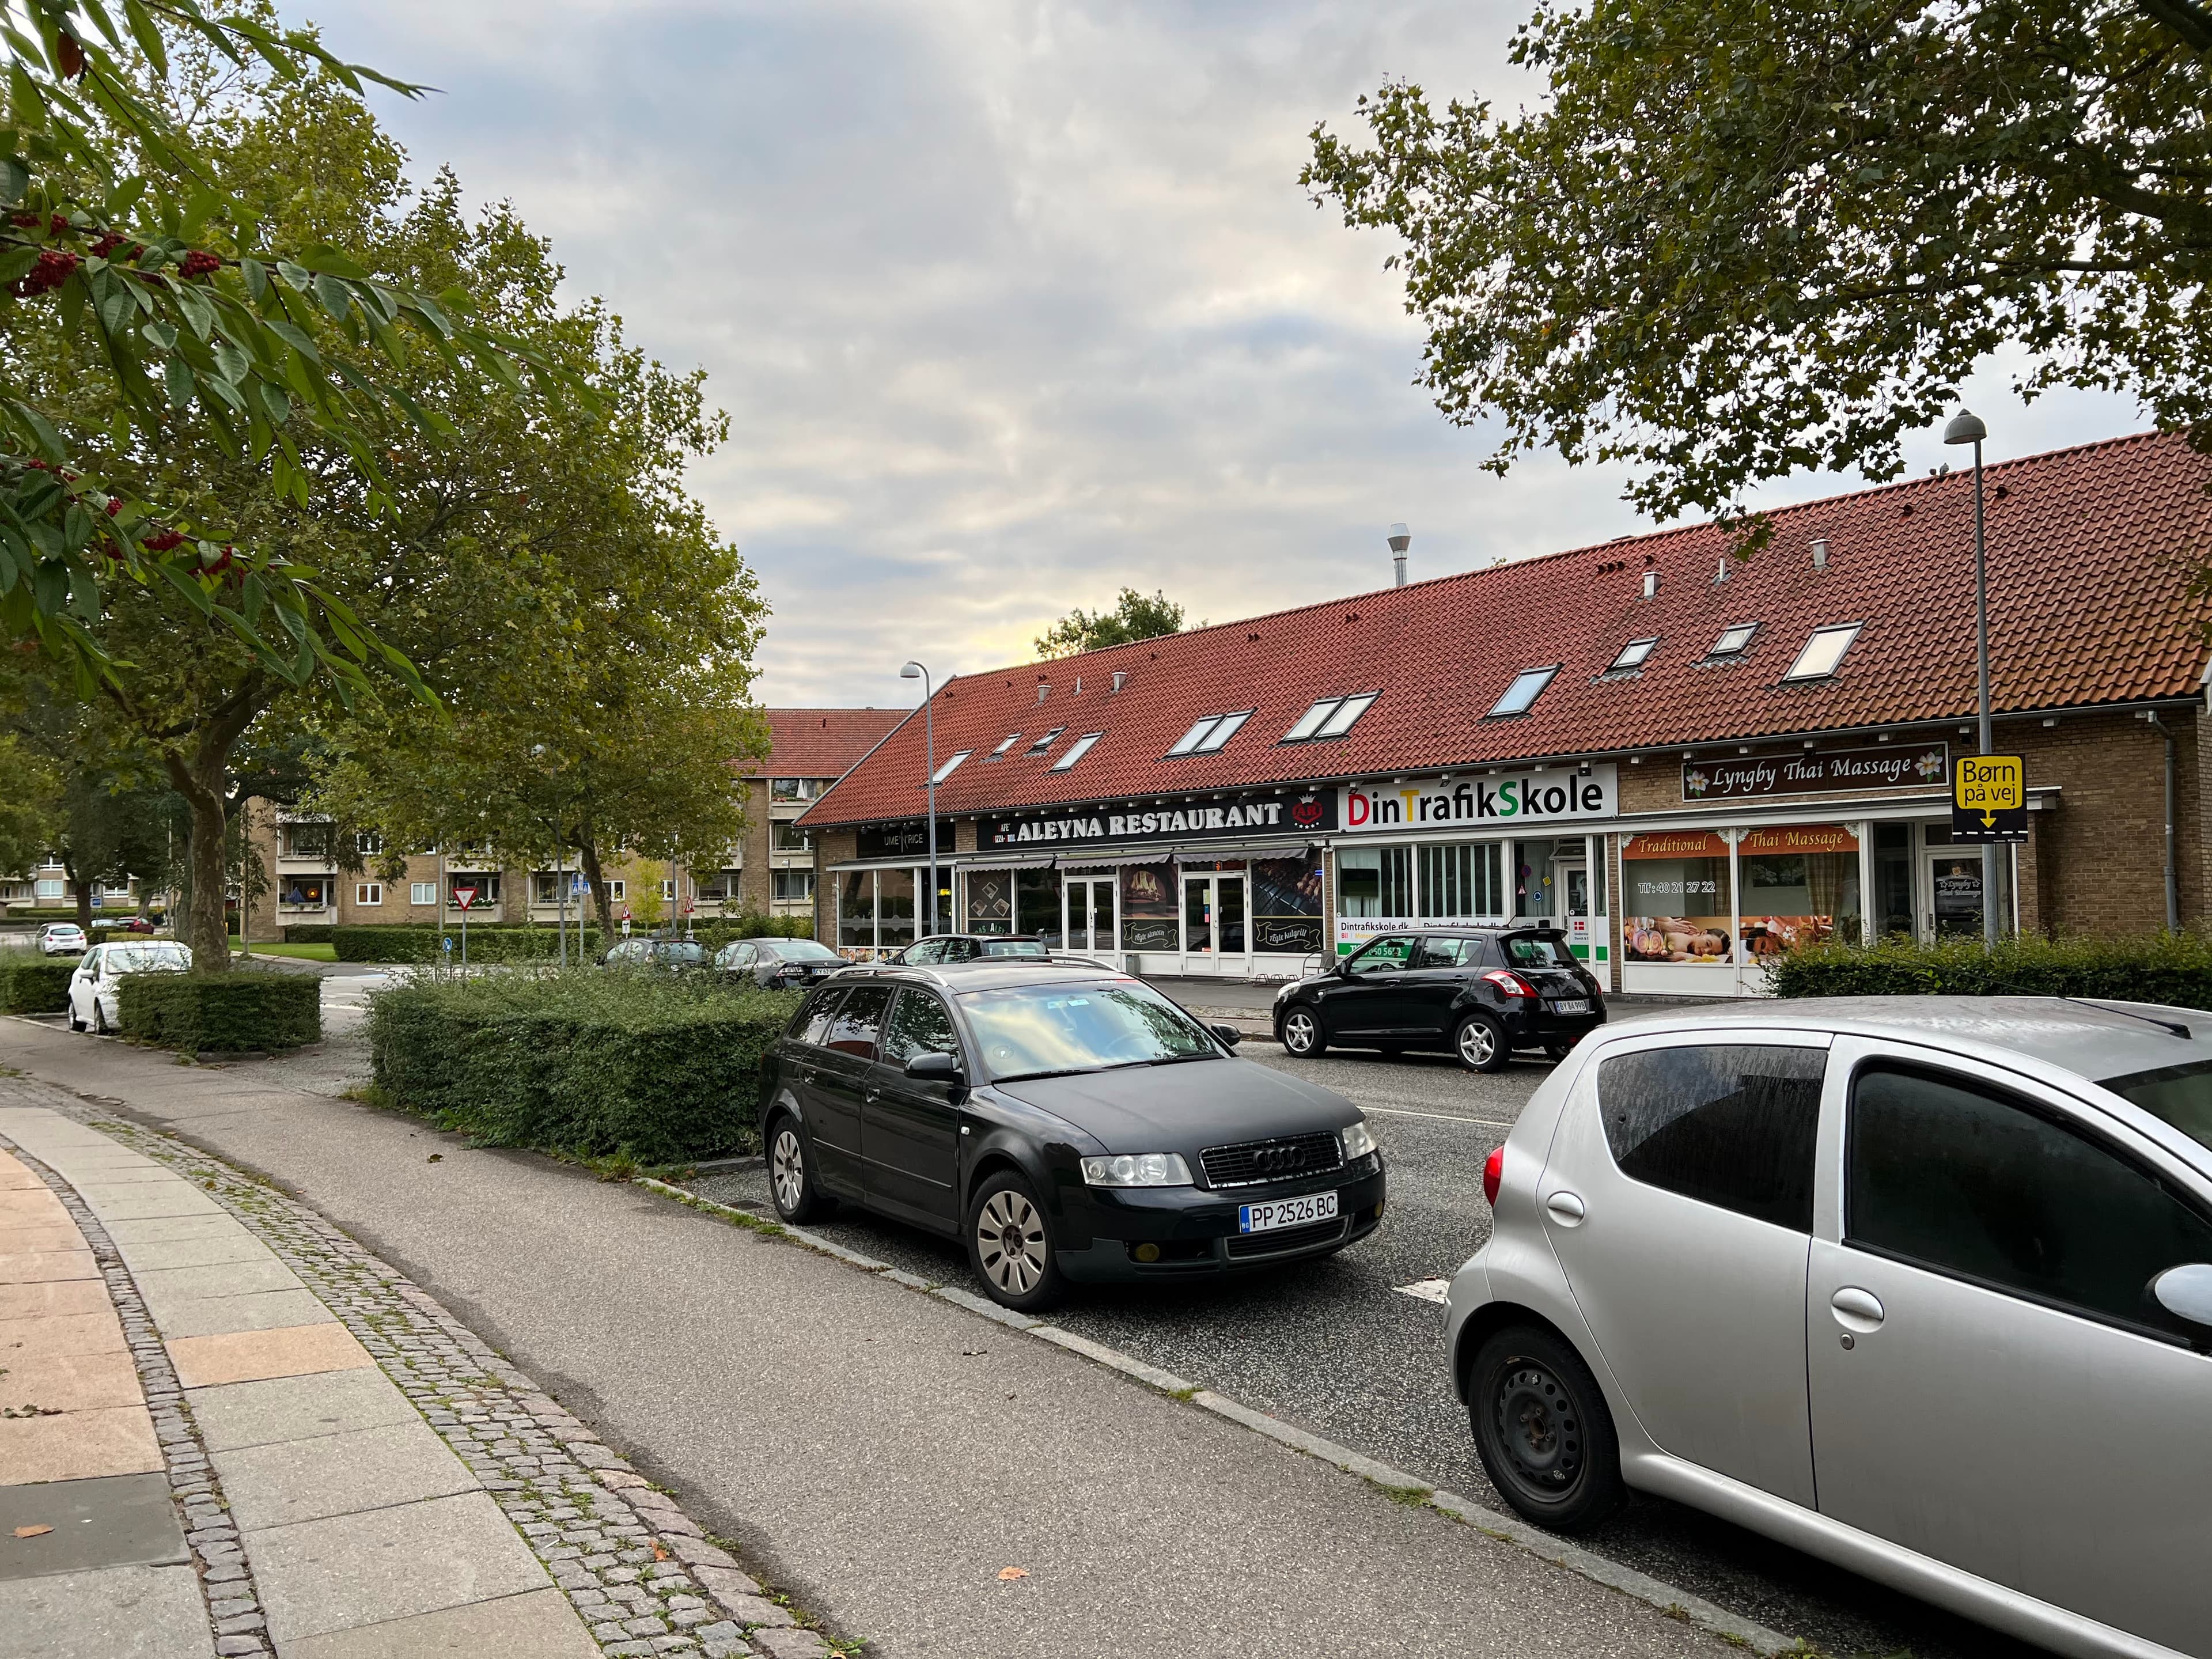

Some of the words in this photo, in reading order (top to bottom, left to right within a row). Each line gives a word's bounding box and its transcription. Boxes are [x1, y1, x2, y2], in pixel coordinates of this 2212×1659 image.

[1712, 761, 1777, 793] Lyngby
[1783, 757, 1824, 780] Thai
[1830, 757, 1911, 782] Massage
[1963, 760, 2015, 783] Børn
[1348, 774, 1603, 826] DinTrafikSkole
[1965, 783, 1986, 806] på
[1990, 783, 2016, 806] vej
[1017, 818, 1104, 842] ALEYNA
[1109, 802, 1283, 836] RESTAURANT
[1638, 834, 1707, 853] Traditional
[1750, 830, 1780, 848] Thai
[1785, 831, 1844, 852] Massage
[1656, 882, 1670, 893] 40
[1671, 881, 1684, 893] 21
[1686, 881, 1700, 893] 27
[1702, 881, 1716, 893] 22
[1270, 933, 1284, 944] Ægte
[1284, 928, 1307, 940] kulgrill
[1341, 922, 1408, 931] Dintrafikskole.dk
[1559, 1002, 1567, 1010] BY
[1568, 1002, 1575, 1010] 84
[1575, 1001, 1585, 1009] 998
[1252, 1206, 1274, 1228] PP
[1277, 1199, 1314, 1225] 2526
[1316, 1195, 1335, 1217] BC
